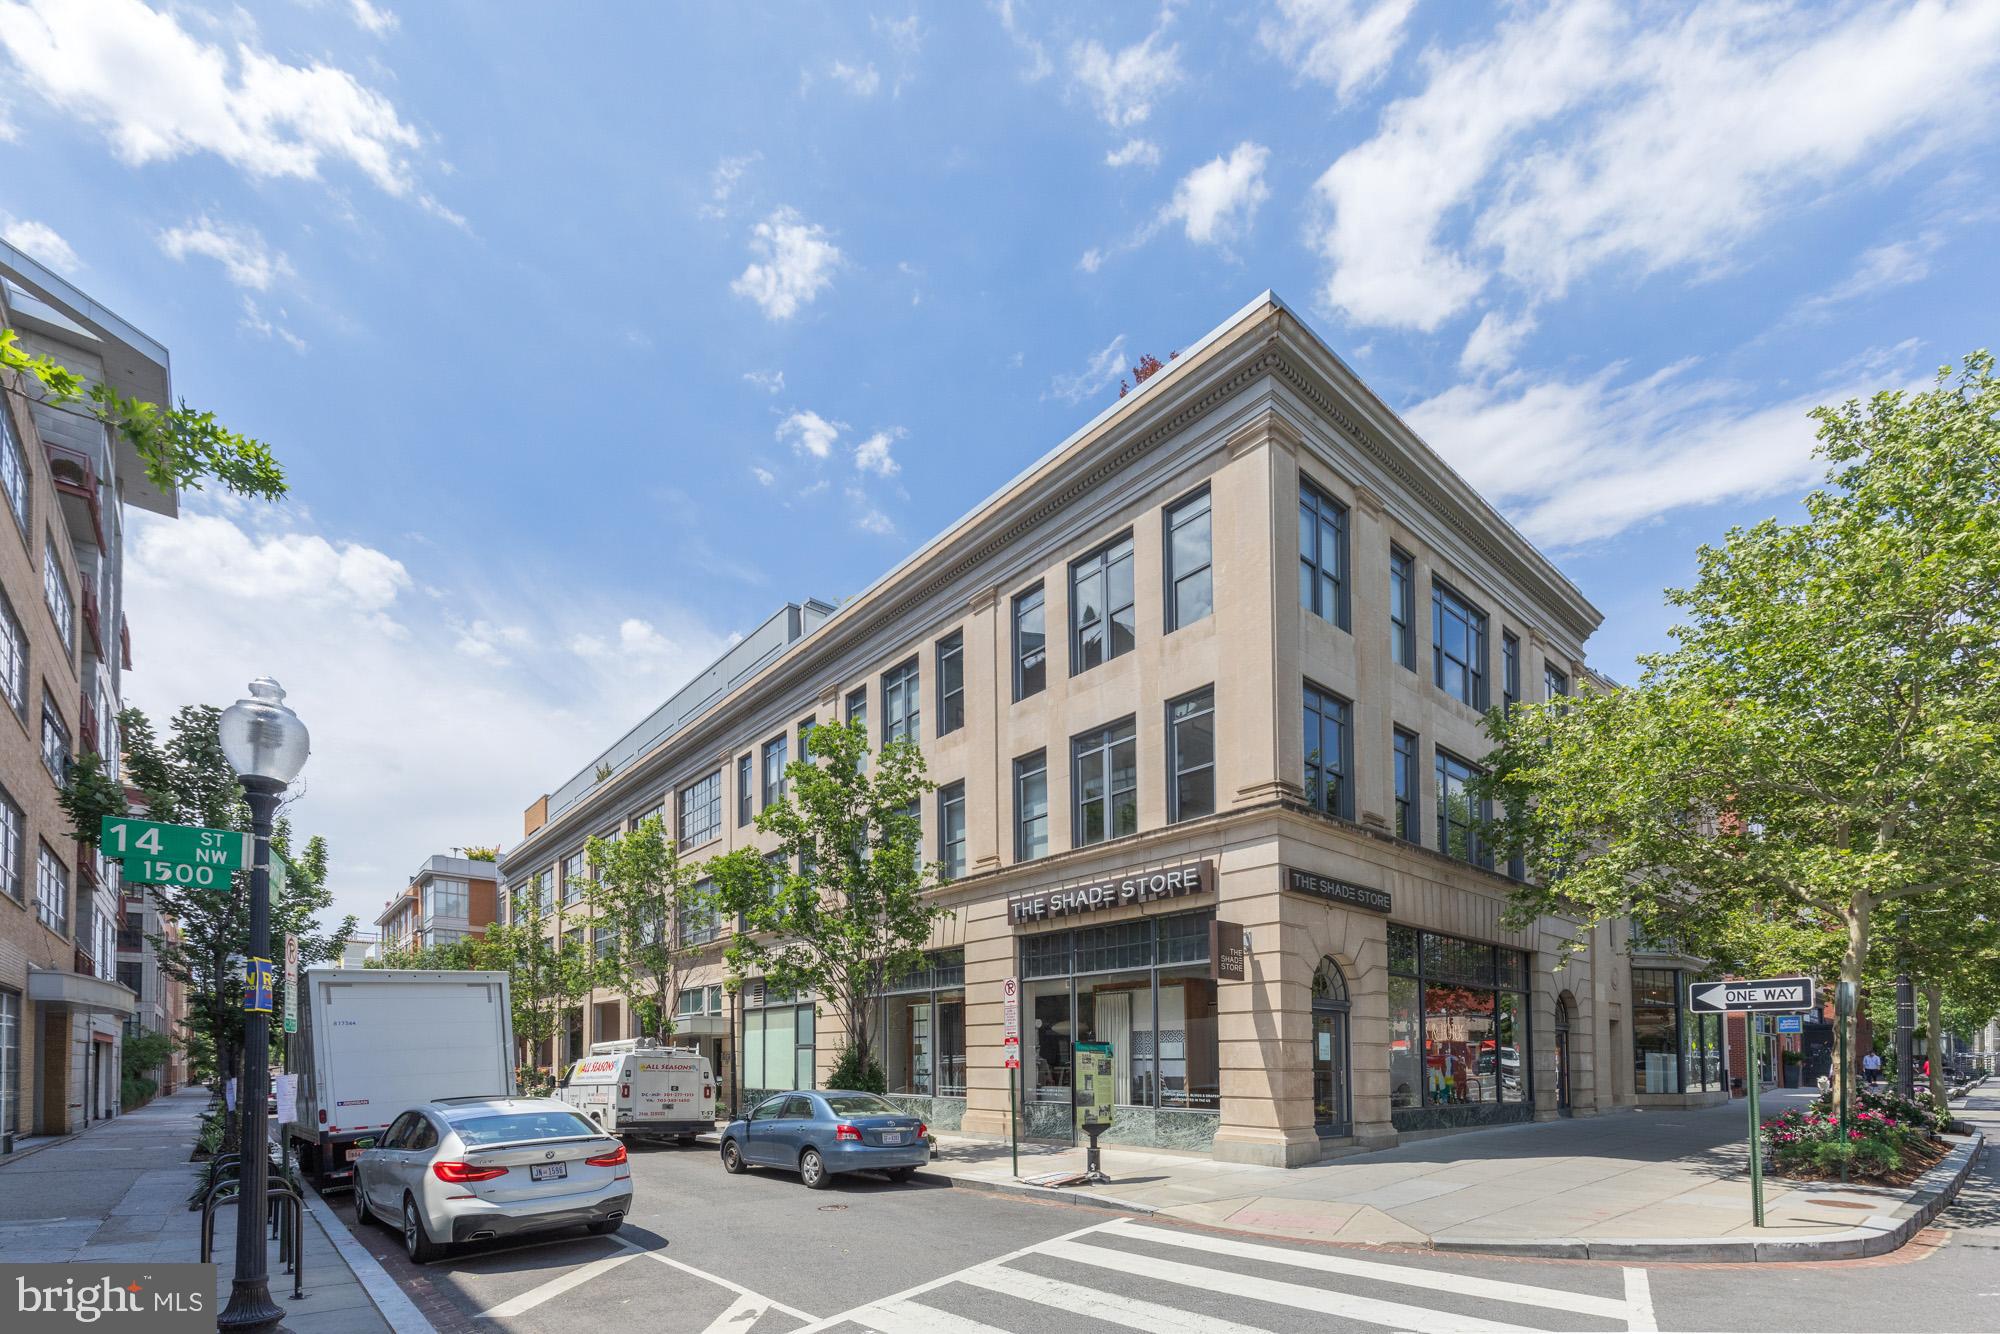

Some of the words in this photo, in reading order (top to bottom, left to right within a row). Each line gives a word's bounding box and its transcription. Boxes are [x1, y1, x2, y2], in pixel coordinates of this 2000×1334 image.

[109, 824, 163, 855] 14
[200, 832, 225, 847] ST
[195, 848, 228, 865] NW
[143, 860, 214, 885] 1500
[1011, 898, 1046, 918] THE
[1050, 883, 1116, 911] SHADE
[1121, 868, 1199, 898] STORE
[1293, 873, 1318, 890] THE
[1320, 880, 1356, 900] SHADE
[1357, 889, 1390, 908] STORE
[1230, 948, 1243, 956] THE
[1221, 955, 1243, 965] SHADE
[1221, 963, 1243, 972] STORE
[1726, 990, 1757, 1002] ONE
[1763, 988, 1797, 1000] WAY
[581, 1063, 591, 1073] ALL
[591, 1061, 615, 1072] SEASONS
